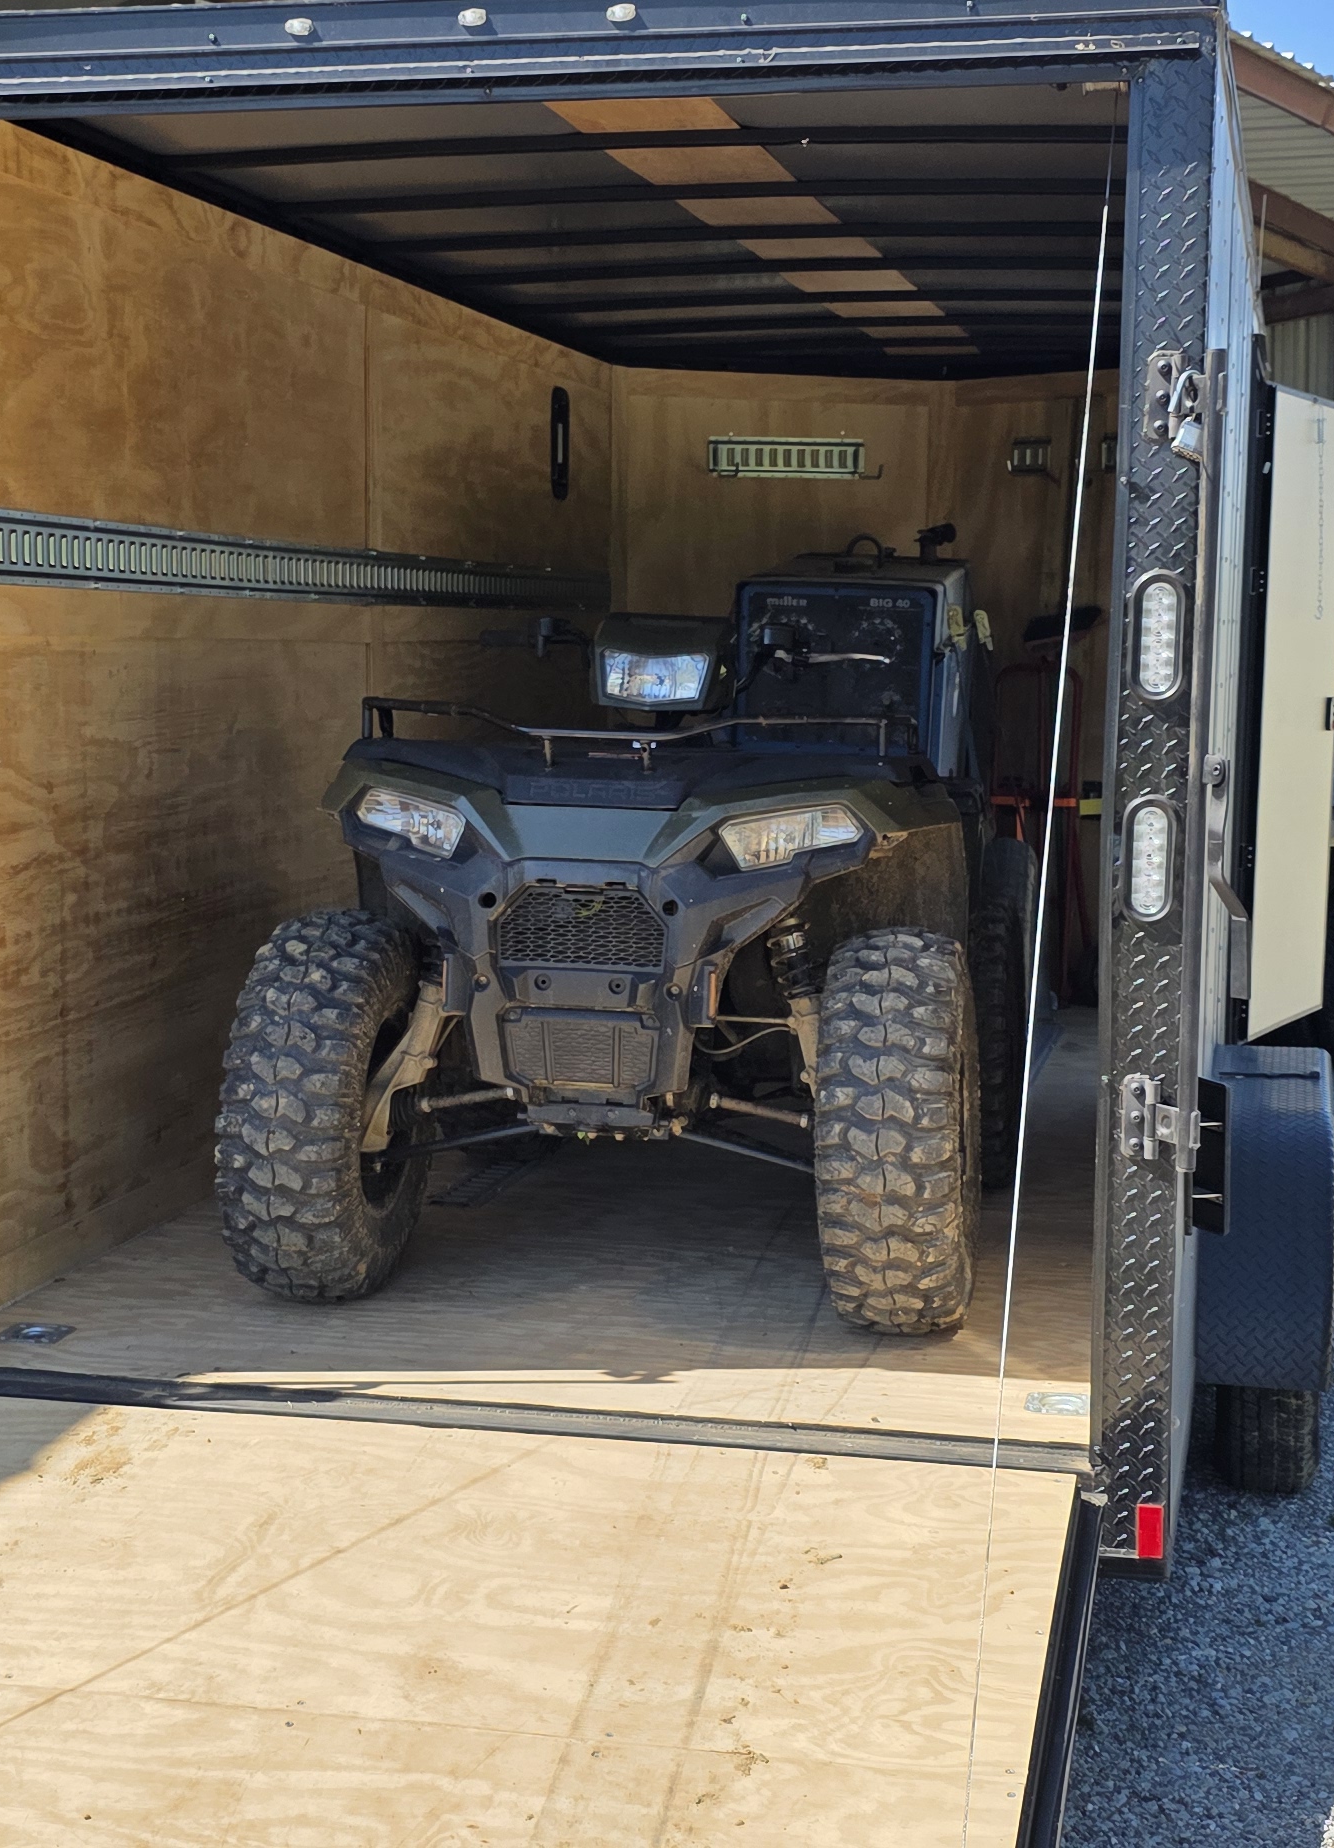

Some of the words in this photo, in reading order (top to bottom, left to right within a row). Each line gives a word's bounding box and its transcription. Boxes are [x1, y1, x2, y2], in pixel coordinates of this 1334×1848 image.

[869, 598, 893, 608] BIG
[895, 598, 911, 609] 40
[529, 780, 657, 801] POLARIS
